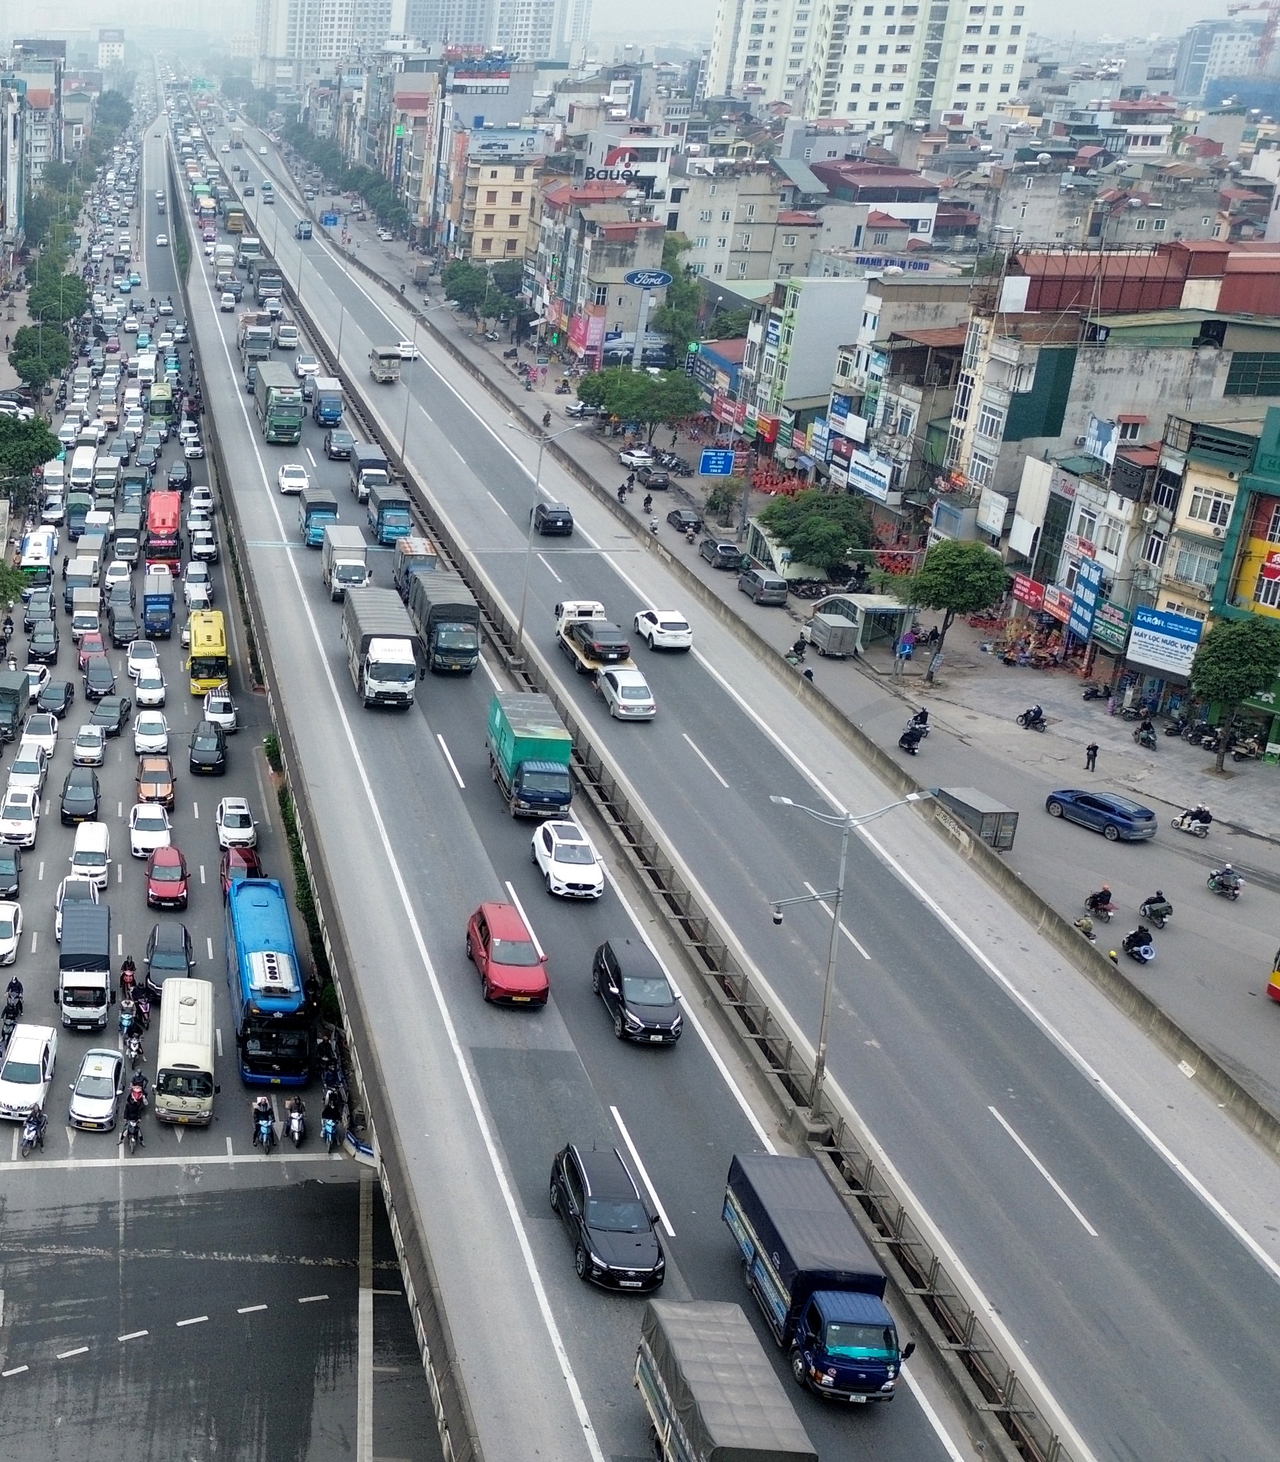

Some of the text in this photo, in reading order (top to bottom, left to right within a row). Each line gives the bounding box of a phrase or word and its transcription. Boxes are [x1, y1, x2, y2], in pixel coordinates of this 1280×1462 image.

[585, 166, 640, 180] Bauer
[907, 260, 930, 271] FORD
[633, 272, 665, 285] Ford
[1133, 630, 1148, 640] MÁY
[1148, 634, 1160, 644] LỌC
[1180, 643, 1195, 653] VIỆT
